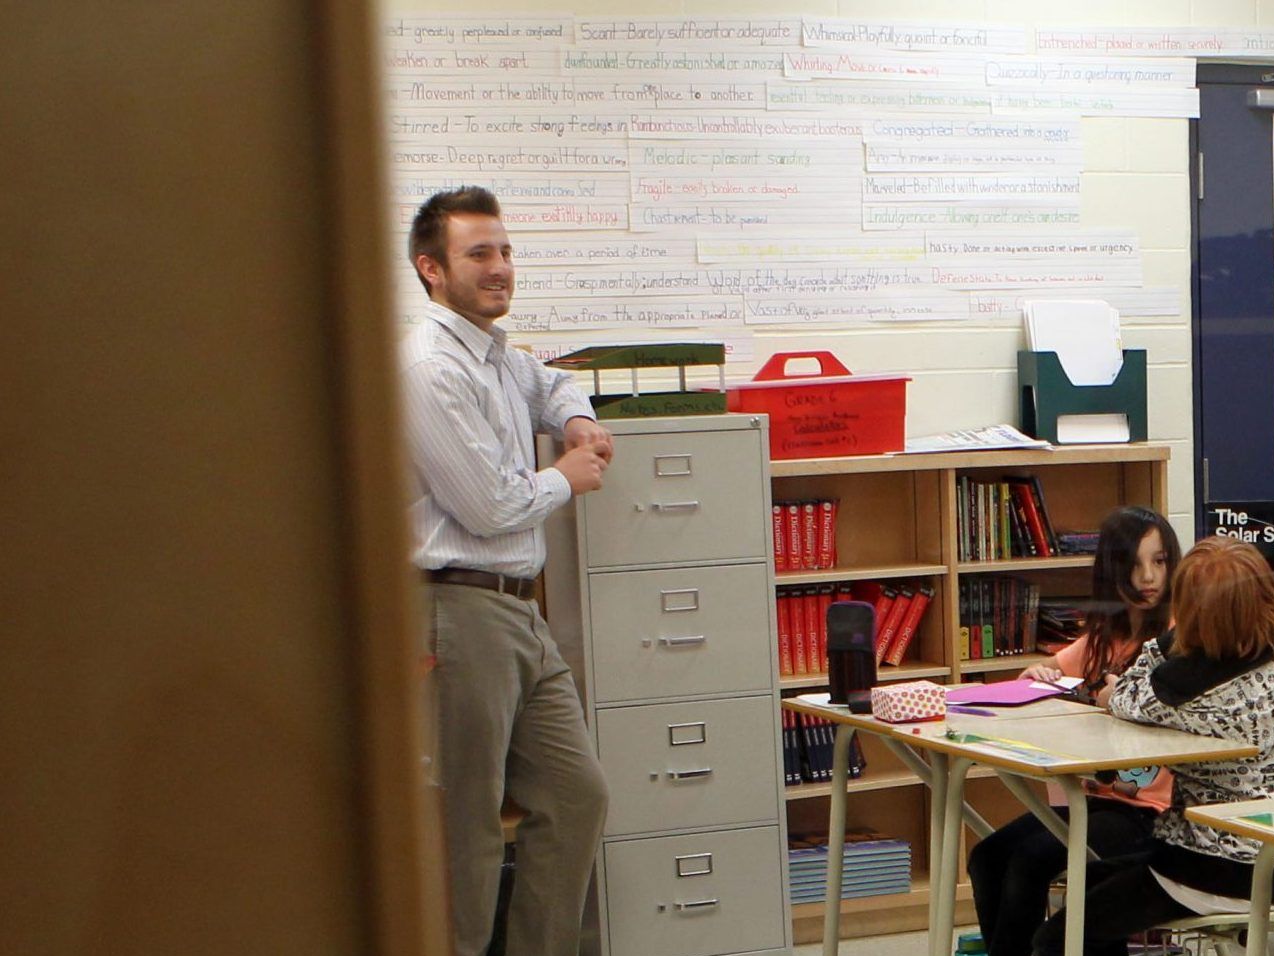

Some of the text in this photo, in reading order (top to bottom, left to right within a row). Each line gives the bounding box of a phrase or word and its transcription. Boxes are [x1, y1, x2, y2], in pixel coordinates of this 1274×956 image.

[415, 26, 455, 43] greatly
[455, 49, 490, 68] break
[499, 51, 531, 70] apart
[410, 82, 475, 101] Movement
[482, 90, 493, 100] or
[499, 82, 521, 100] the
[526, 82, 560, 104] ability
[577, 90, 605, 100] move
[690, 82, 703, 101] to
[391, 115, 449, 134] Stirred
[486, 115, 524, 133] excite
[530, 115, 566, 138] strong
[448, 145, 485, 170] Deep
[638, 177, 673, 201] Fragile
[545, 249, 570, 259] over
[588, 248, 619, 262] period
[626, 240, 639, 259] of
[565, 271, 597, 295] Grasp
[580, 306, 607, 321] from
[1214, 507, 1249, 526] The
[774, 516, 784, 556] Dictionary
[789, 515, 800, 556] Dictionary
[804, 514, 816, 555] Dictionary
[820, 512, 831, 553] Dictionary
[1215, 526, 1260, 543] Solar
